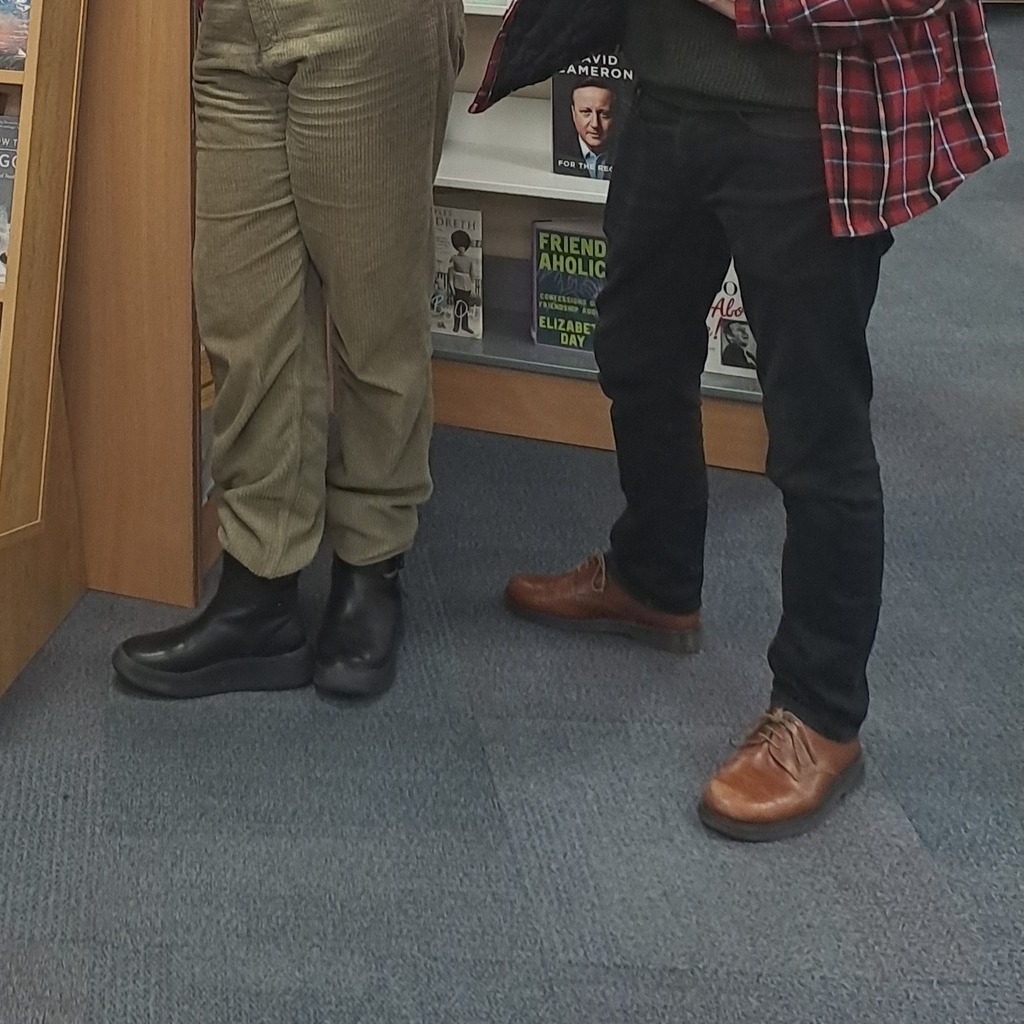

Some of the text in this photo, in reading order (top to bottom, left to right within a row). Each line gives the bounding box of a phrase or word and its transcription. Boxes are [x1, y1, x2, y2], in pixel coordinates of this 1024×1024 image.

[581, 54, 618, 65] AVID
[559, 64, 633, 80] AMERON
[578, 162, 594, 170] THE
[598, 164, 613, 172] REC
[539, 232, 607, 258] FRIEND
[539, 253, 606, 278] AHOLIC
[539, 293, 587, 305] CONFESSIONS
[539, 301, 579, 313] FRIENDSHIP
[711, 297, 744, 318] Abo
[539, 316, 596, 334] ELIZABET
[560, 333, 585, 347] DAY
